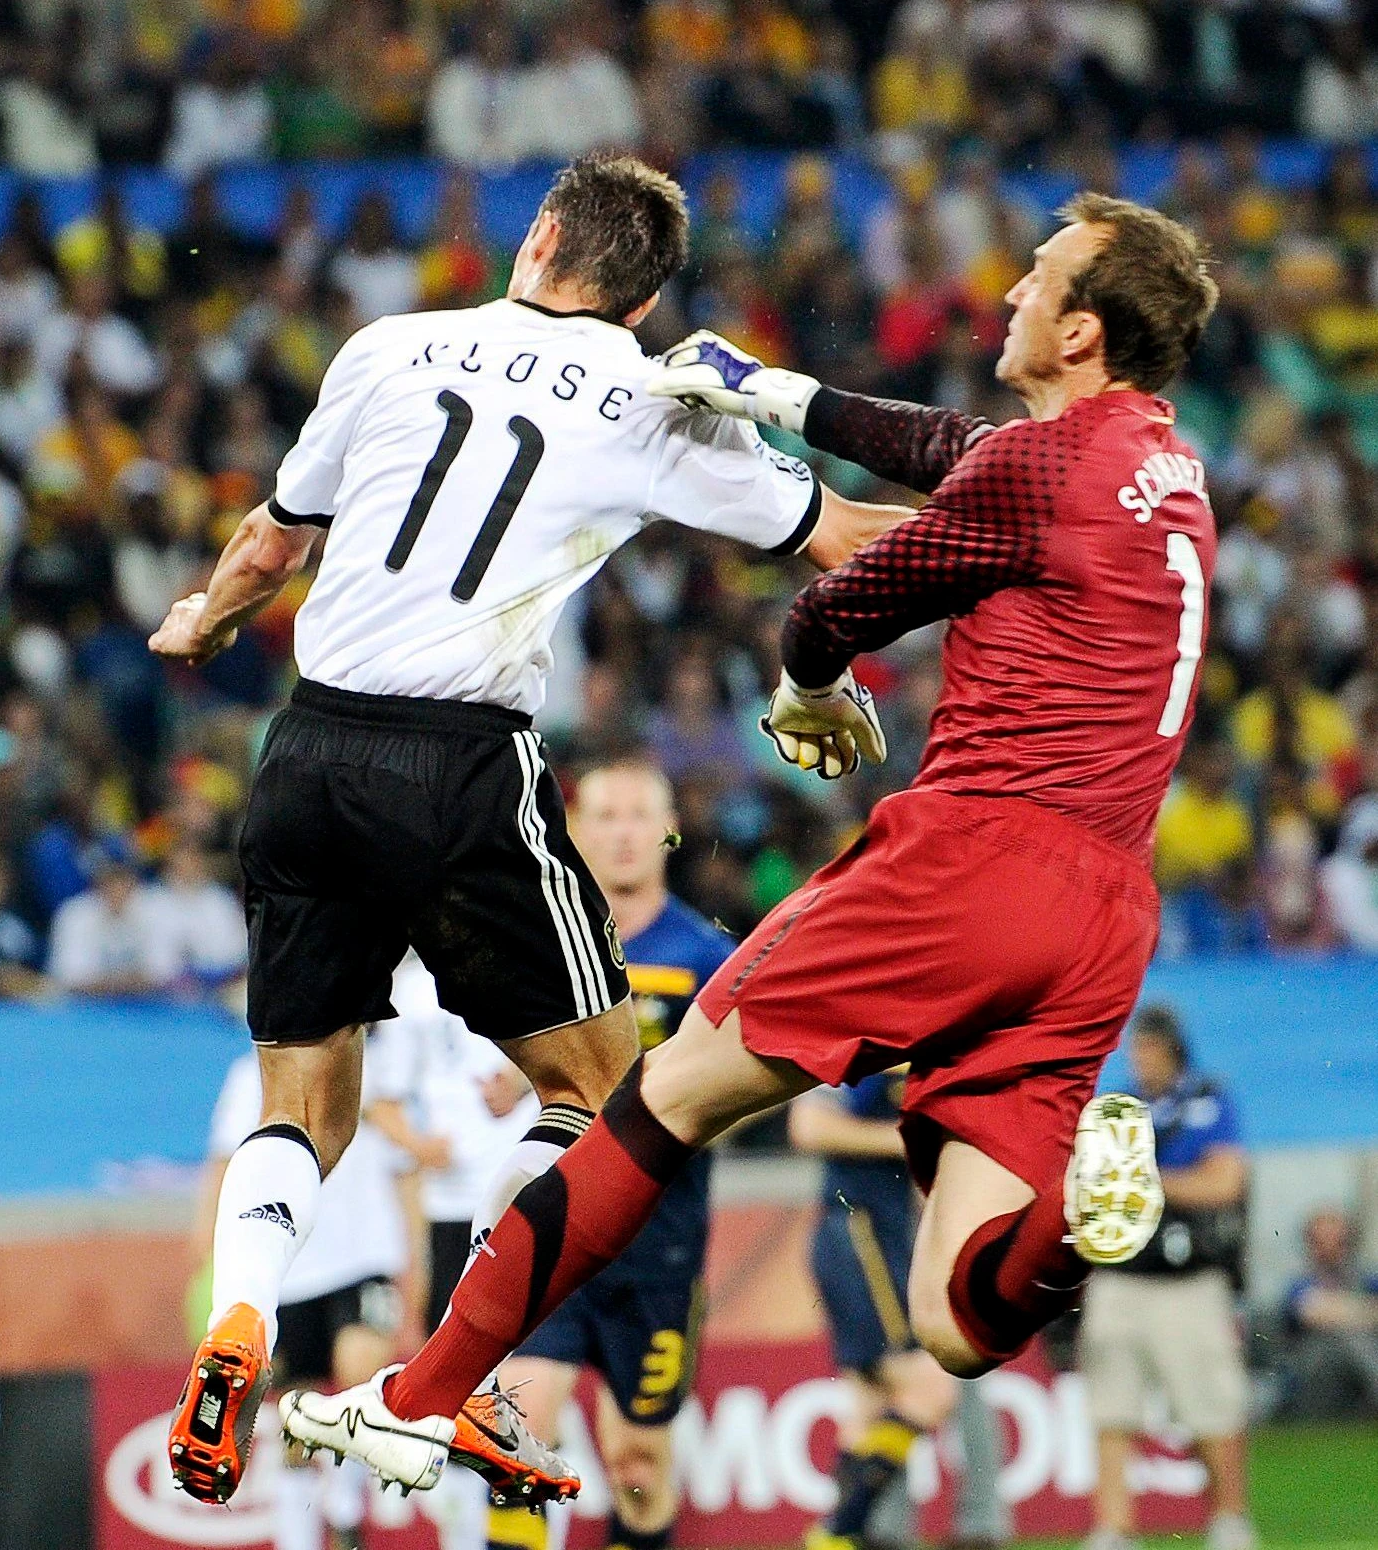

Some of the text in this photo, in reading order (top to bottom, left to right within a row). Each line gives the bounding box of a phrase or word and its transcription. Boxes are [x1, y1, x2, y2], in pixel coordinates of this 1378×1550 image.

[384, 388, 545, 604] 11
[1157, 532, 1204, 738] 1
[640, 1328, 685, 1395] 3
